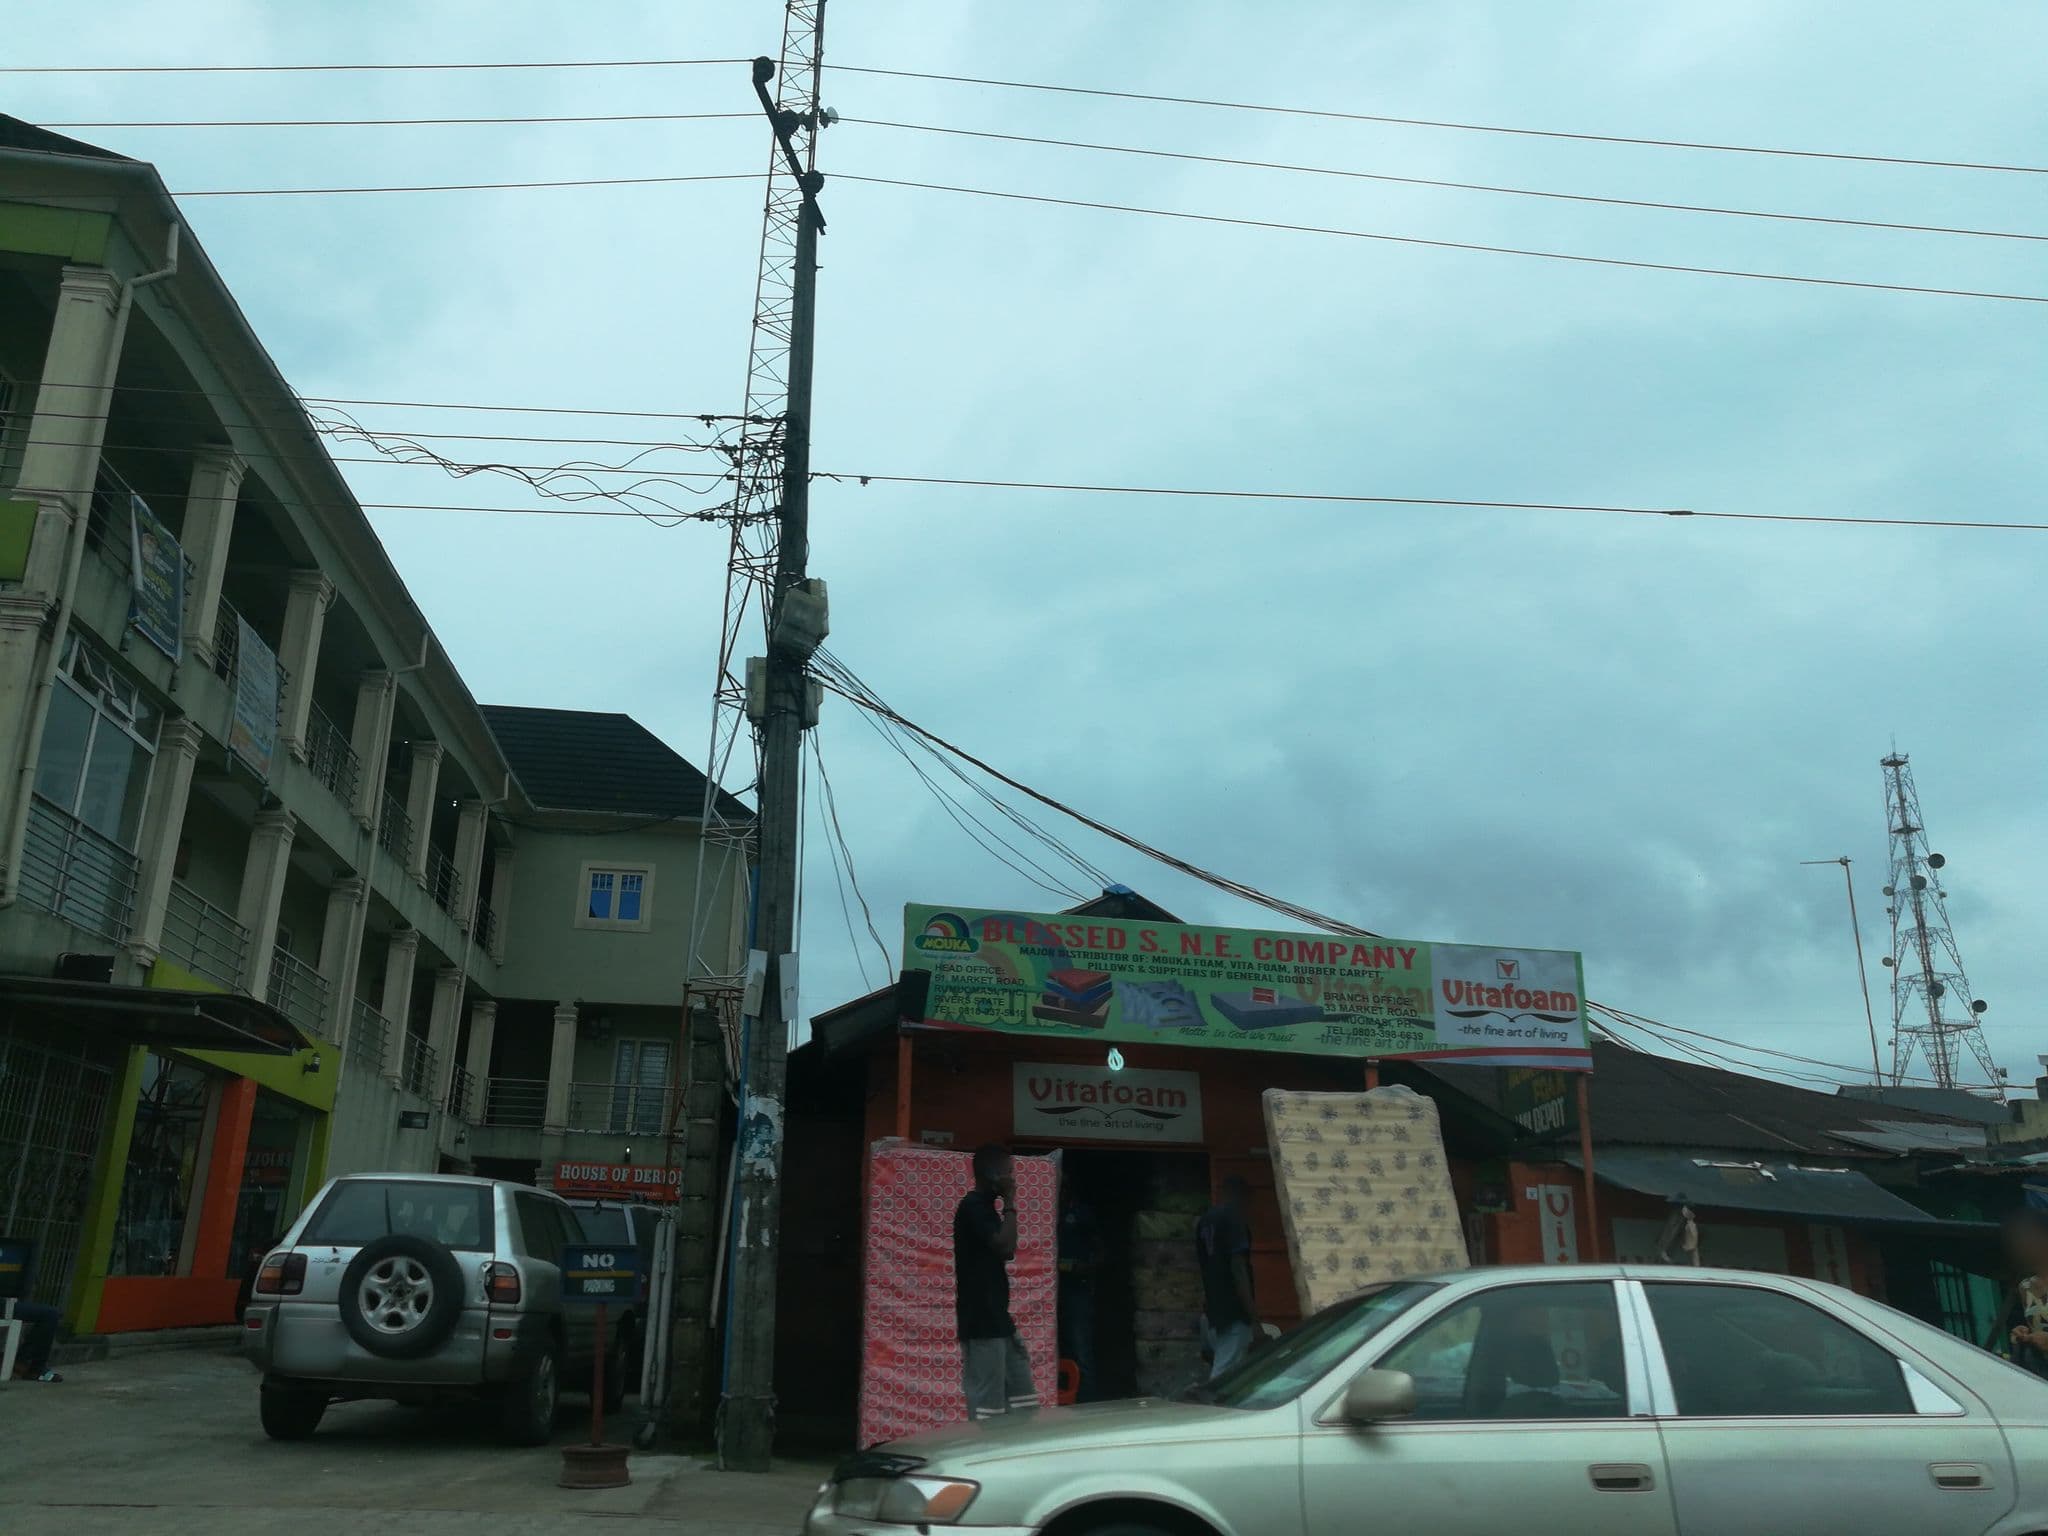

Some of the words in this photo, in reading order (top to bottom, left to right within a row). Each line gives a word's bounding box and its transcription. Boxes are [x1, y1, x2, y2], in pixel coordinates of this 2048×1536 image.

[923, 937, 971, 951] MOUKA
[983, 918, 1126, 950] BLESSED
[1139, 929, 1168, 953] S.
[1253, 937, 1417, 970] COMPANY
[935, 963, 963, 973] HEAD
[966, 965, 1006, 975] OFFICE:
[1020, 947, 1055, 957] MAJOR
[1057, 947, 1129, 962] DISTRIBUTOR
[1132, 954, 1148, 963] OF:
[1152, 955, 1190, 967] MOUKA
[1194, 958, 1226, 969] FOAM,
[1230, 960, 1254, 970] VITA
[1294, 966, 1336, 976] RUBBER
[952, 975, 993, 984] MARKET
[1088, 962, 1134, 973] PILLOWS
[1138, 964, 1146, 973] &
[1149, 965, 1206, 978] SUPPLIERS
[1210, 970, 1223, 978] OF
[1226, 971, 1274, 982] GENERAL
[935, 995, 971, 1005] RIVERS
[975, 997, 1005, 1006] STATE
[1323, 992, 1368, 1003] BRANCH
[1442, 979, 1577, 1011] Vitafoam
[1325, 1003, 1336, 1012] 33
[1340, 1004, 1384, 1015] MARKET
[1484, 1025, 1504, 1037] fine
[1507, 1028, 1522, 1038] art
[1525, 1028, 1538, 1039] of
[1540, 1029, 1568, 1042] living
[1028, 1077, 1187, 1107] Vitafoam
[1059, 1117, 1076, 1127] the
[1080, 1117, 1100, 1128] fine
[1105, 1118, 1120, 1128] art
[1121, 1118, 1133, 1129] of
[1135, 1119, 1164, 1131] living
[560, 1164, 608, 1181] HOUSE
[612, 1166, 630, 1182] OF
[583, 1253, 615, 1268] NO
